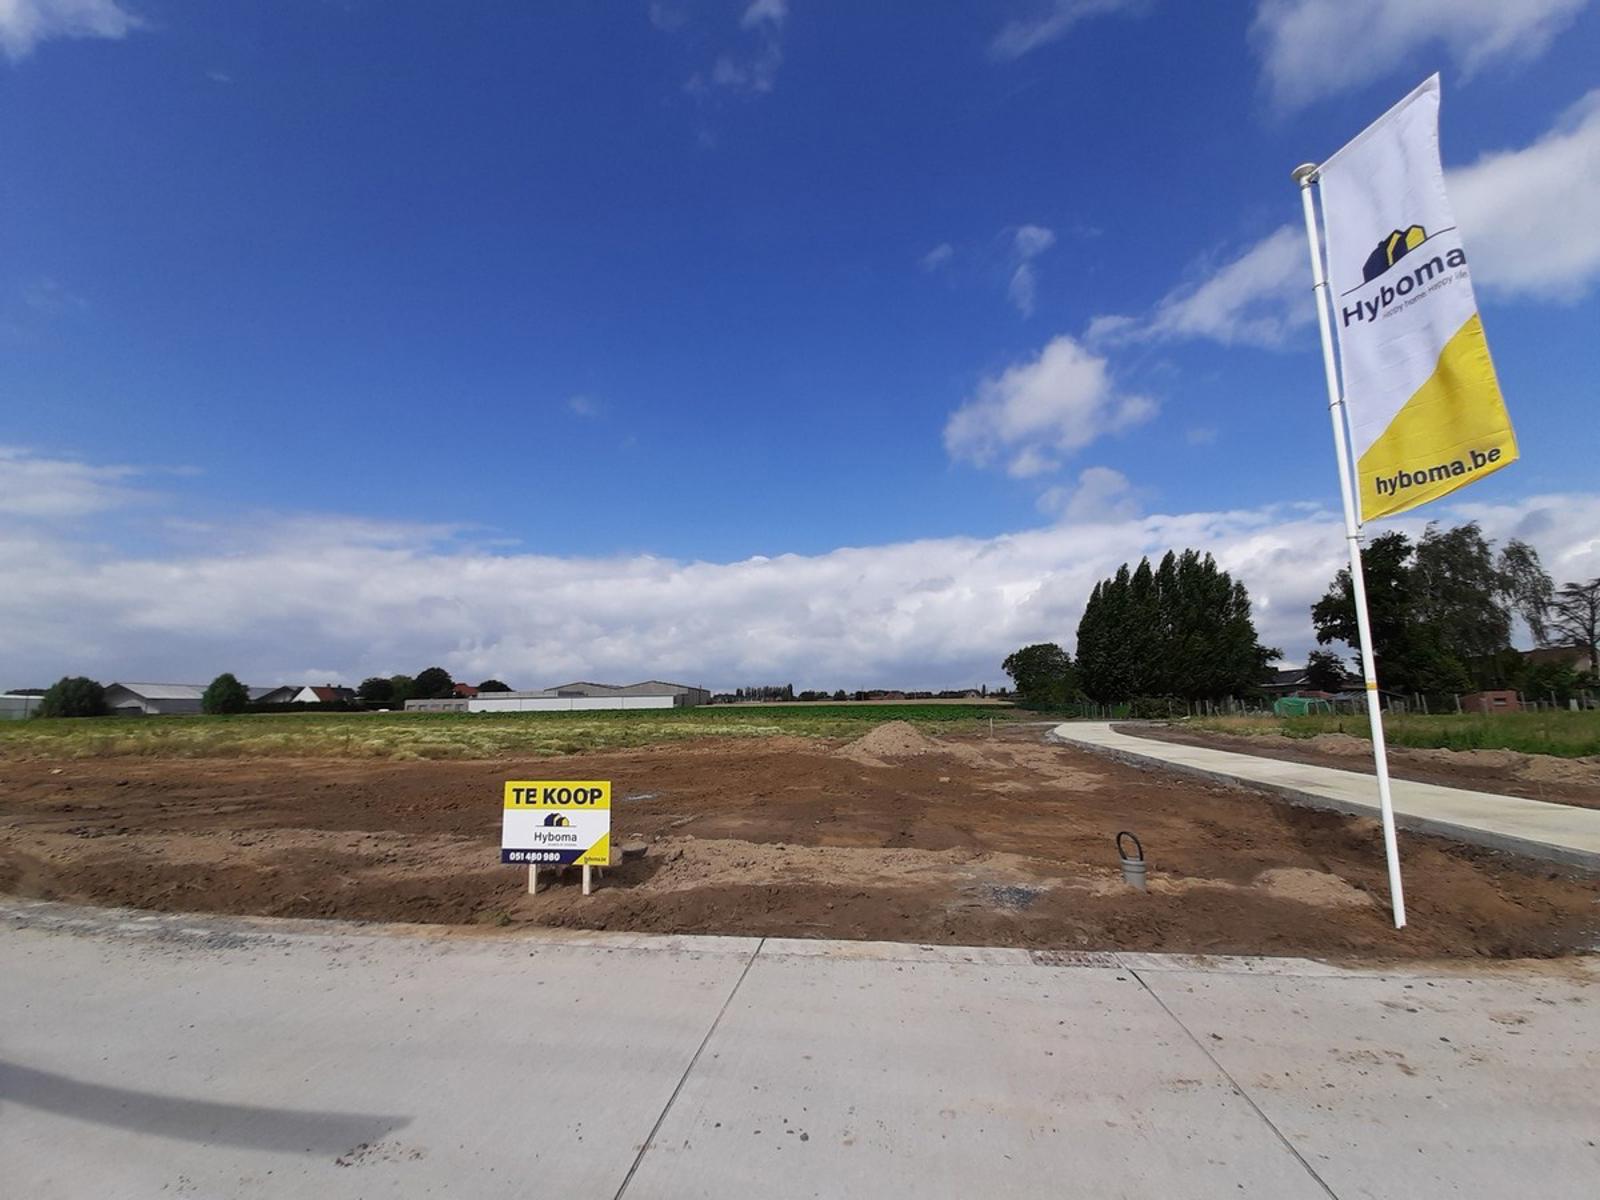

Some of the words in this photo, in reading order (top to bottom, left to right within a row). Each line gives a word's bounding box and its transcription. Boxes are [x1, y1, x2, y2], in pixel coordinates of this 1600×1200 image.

[1342, 248, 1467, 328] Hyboma
[1375, 447, 1502, 497] hyboma.be
[512, 788, 537, 805] TE
[543, 788, 603, 805] KOOP
[534, 832, 577, 844] Hyboma
[509, 852, 524, 861] 051
[543, 852, 560, 861] 980
